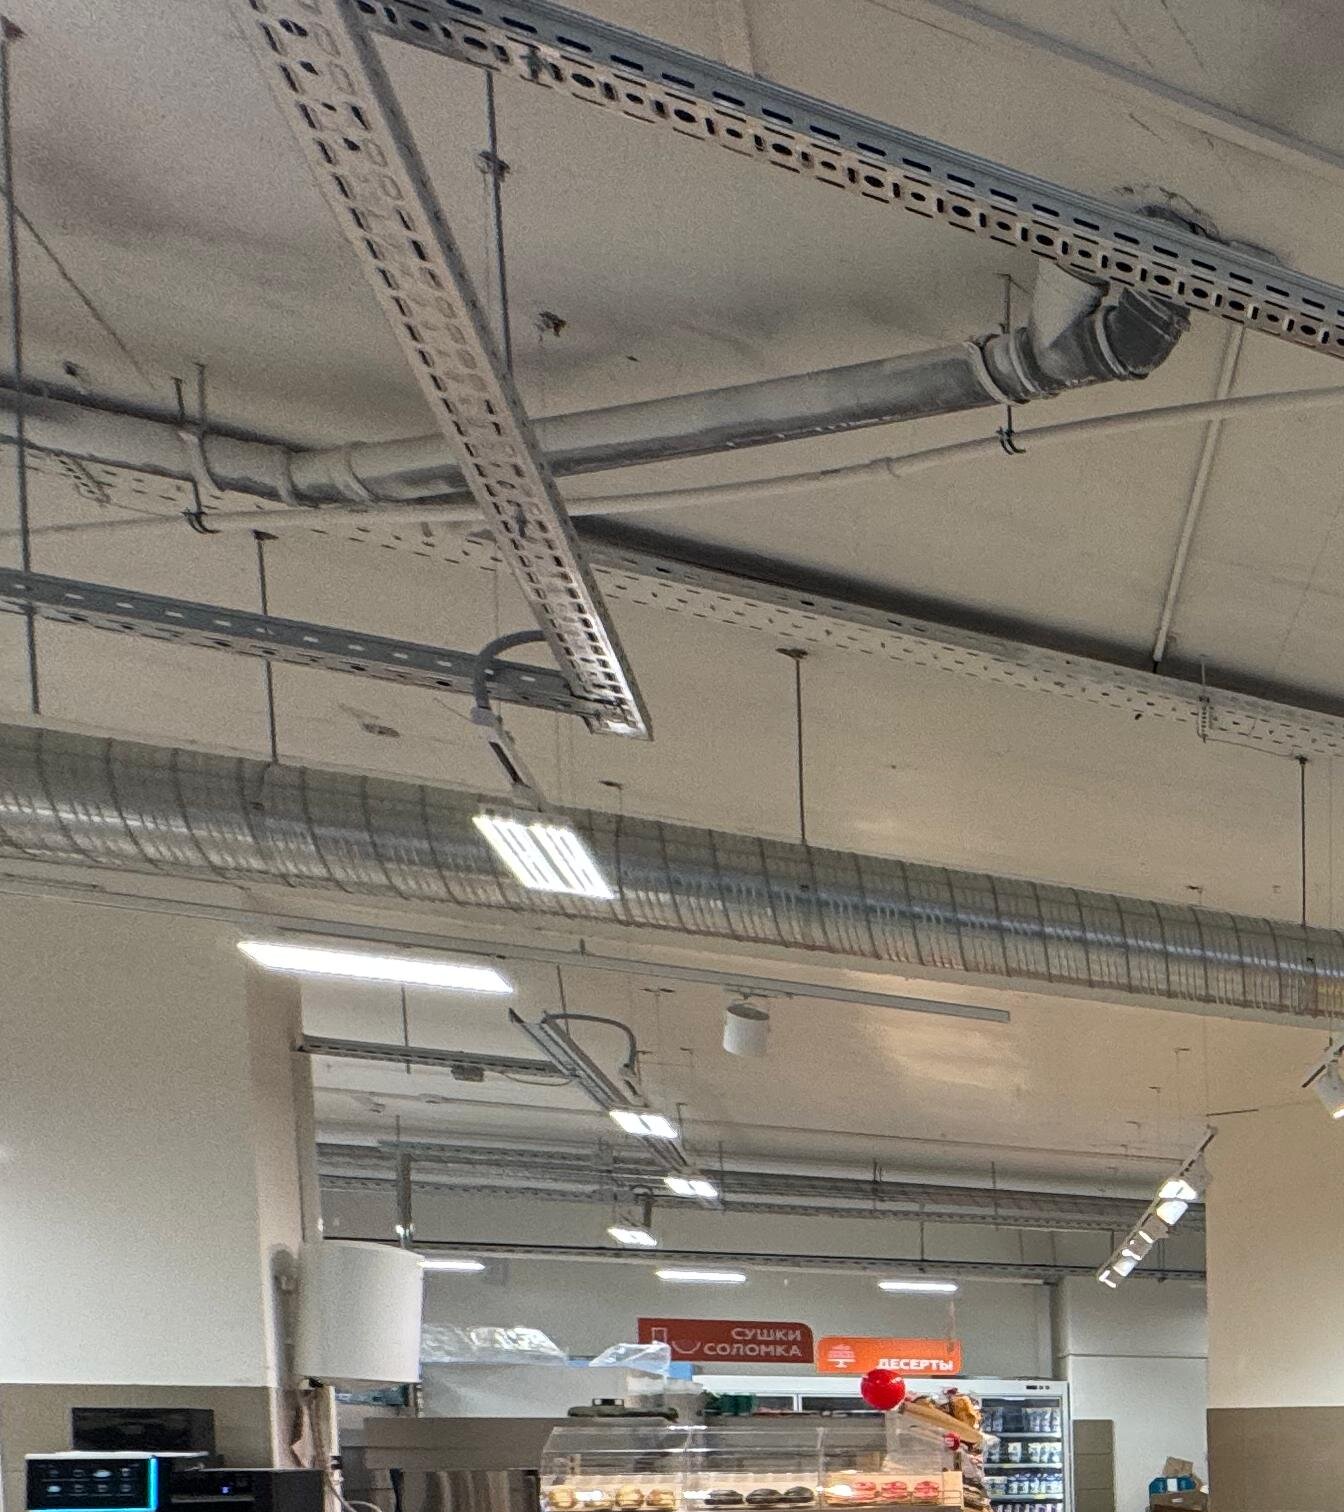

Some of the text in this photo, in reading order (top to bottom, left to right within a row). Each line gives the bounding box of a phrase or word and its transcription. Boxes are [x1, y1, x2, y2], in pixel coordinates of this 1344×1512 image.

[731, 1327, 802, 1341] СУШКИ
[703, 1342, 803, 1357] СОЛОМКА
[876, 1358, 953, 1370] ДЕСЕРТЫ
